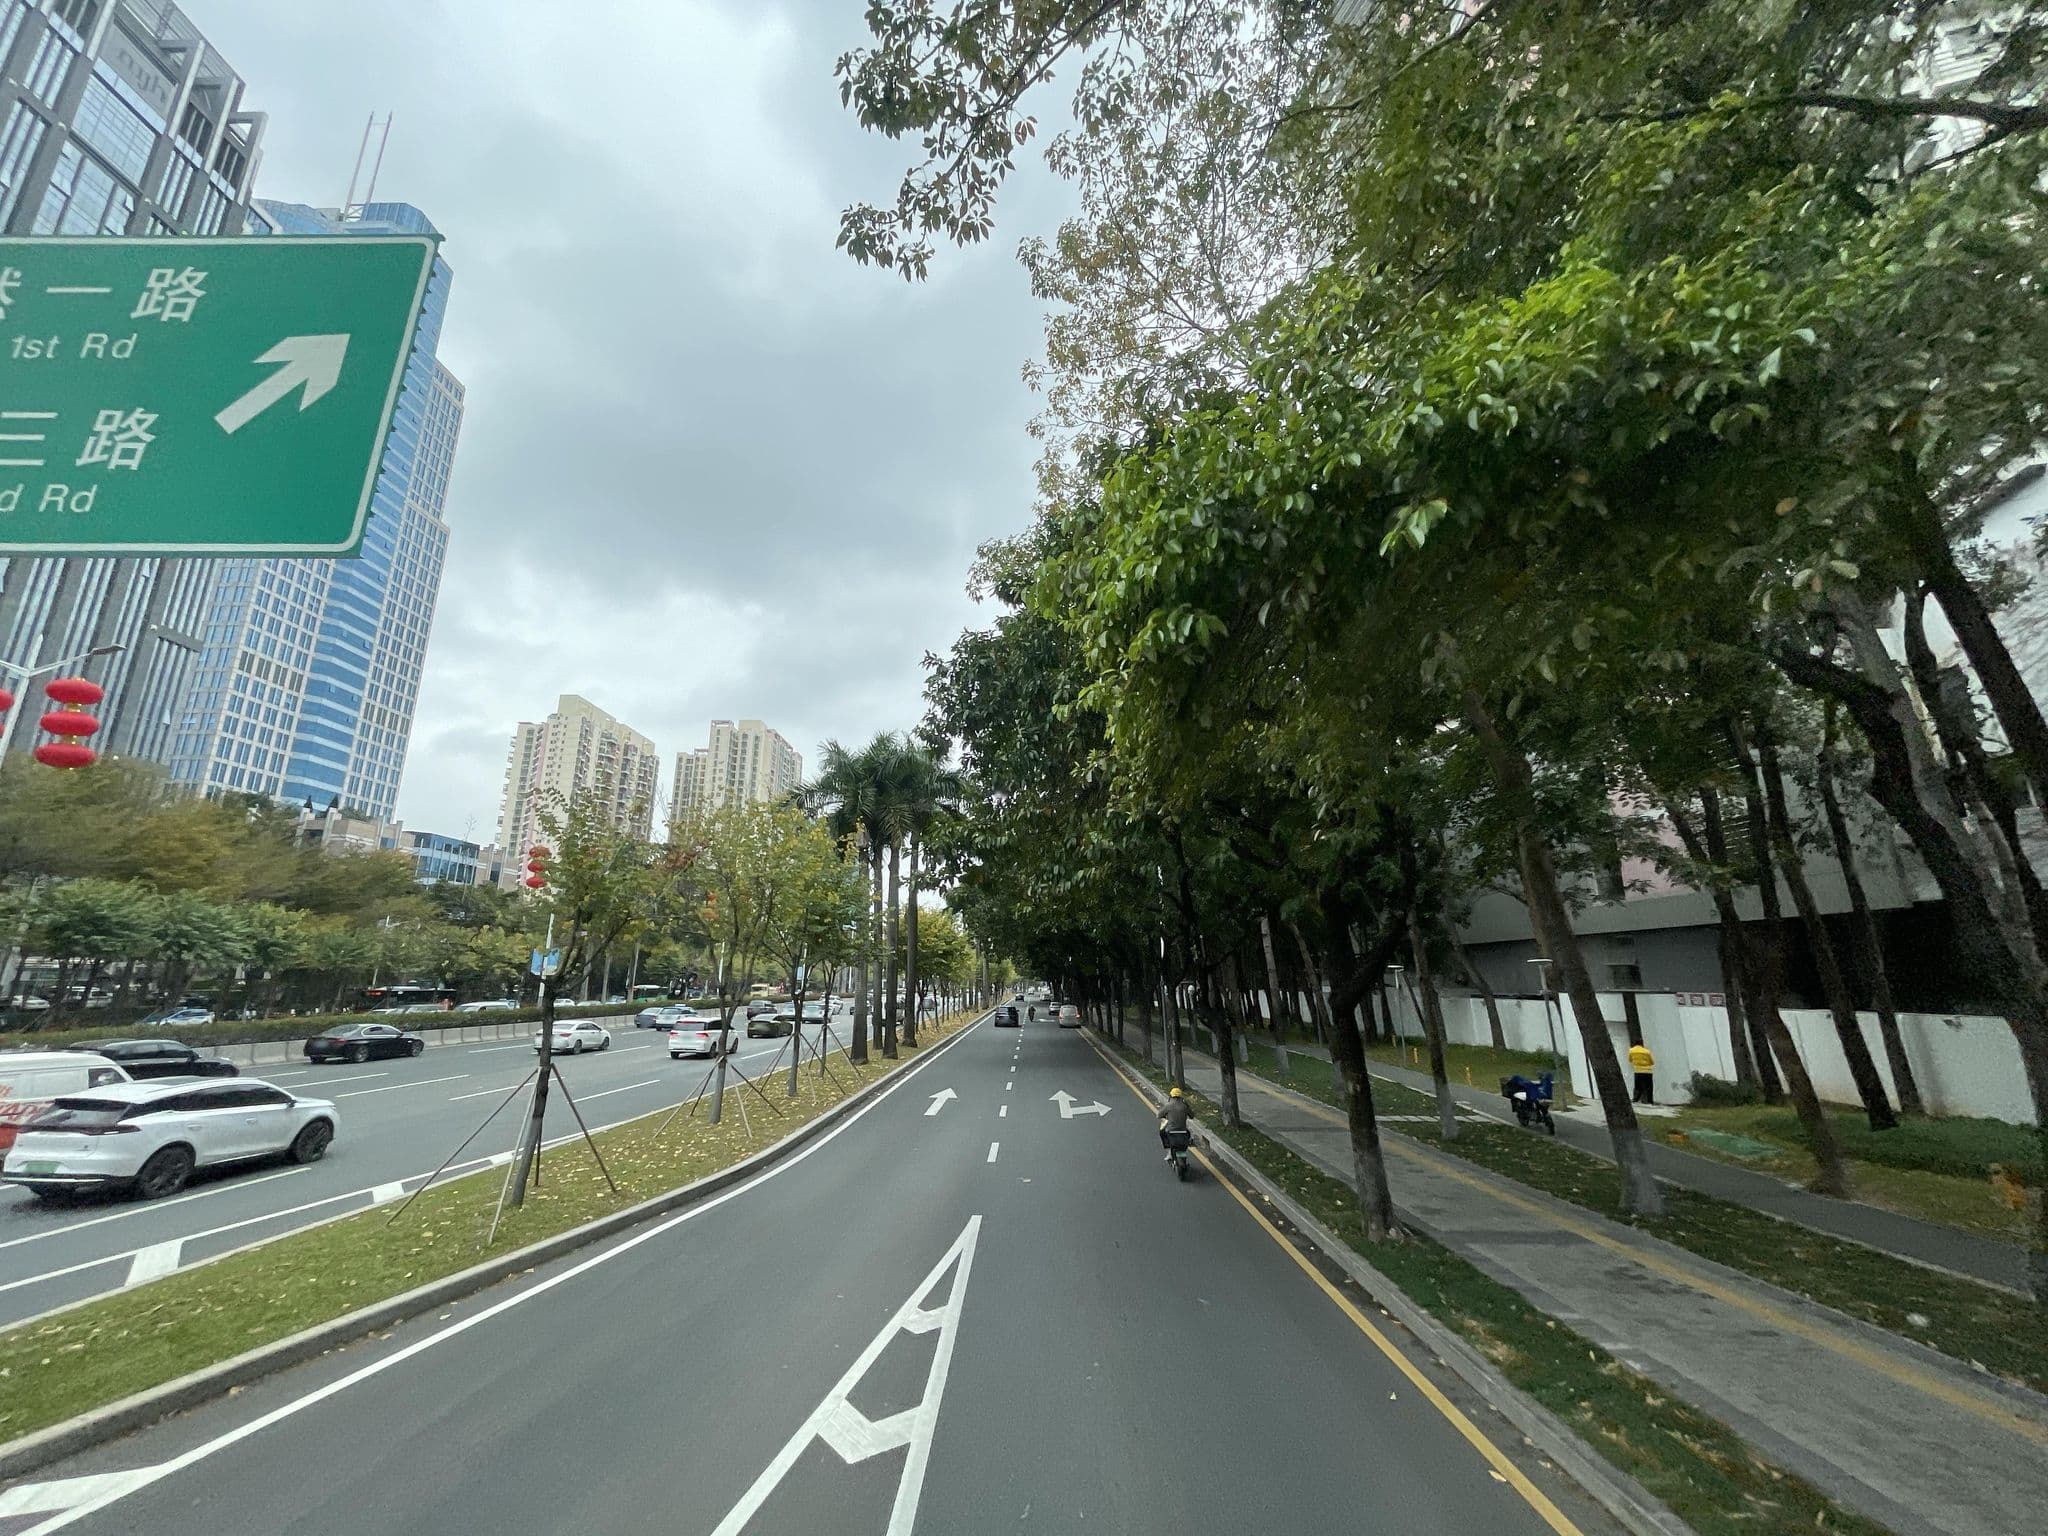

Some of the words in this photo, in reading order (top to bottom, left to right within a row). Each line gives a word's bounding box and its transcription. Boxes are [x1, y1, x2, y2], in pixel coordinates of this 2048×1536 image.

[11, 335, 60, 359] 1st
[80, 333, 138, 359] Rd
[38, 484, 98, 513] Rd
